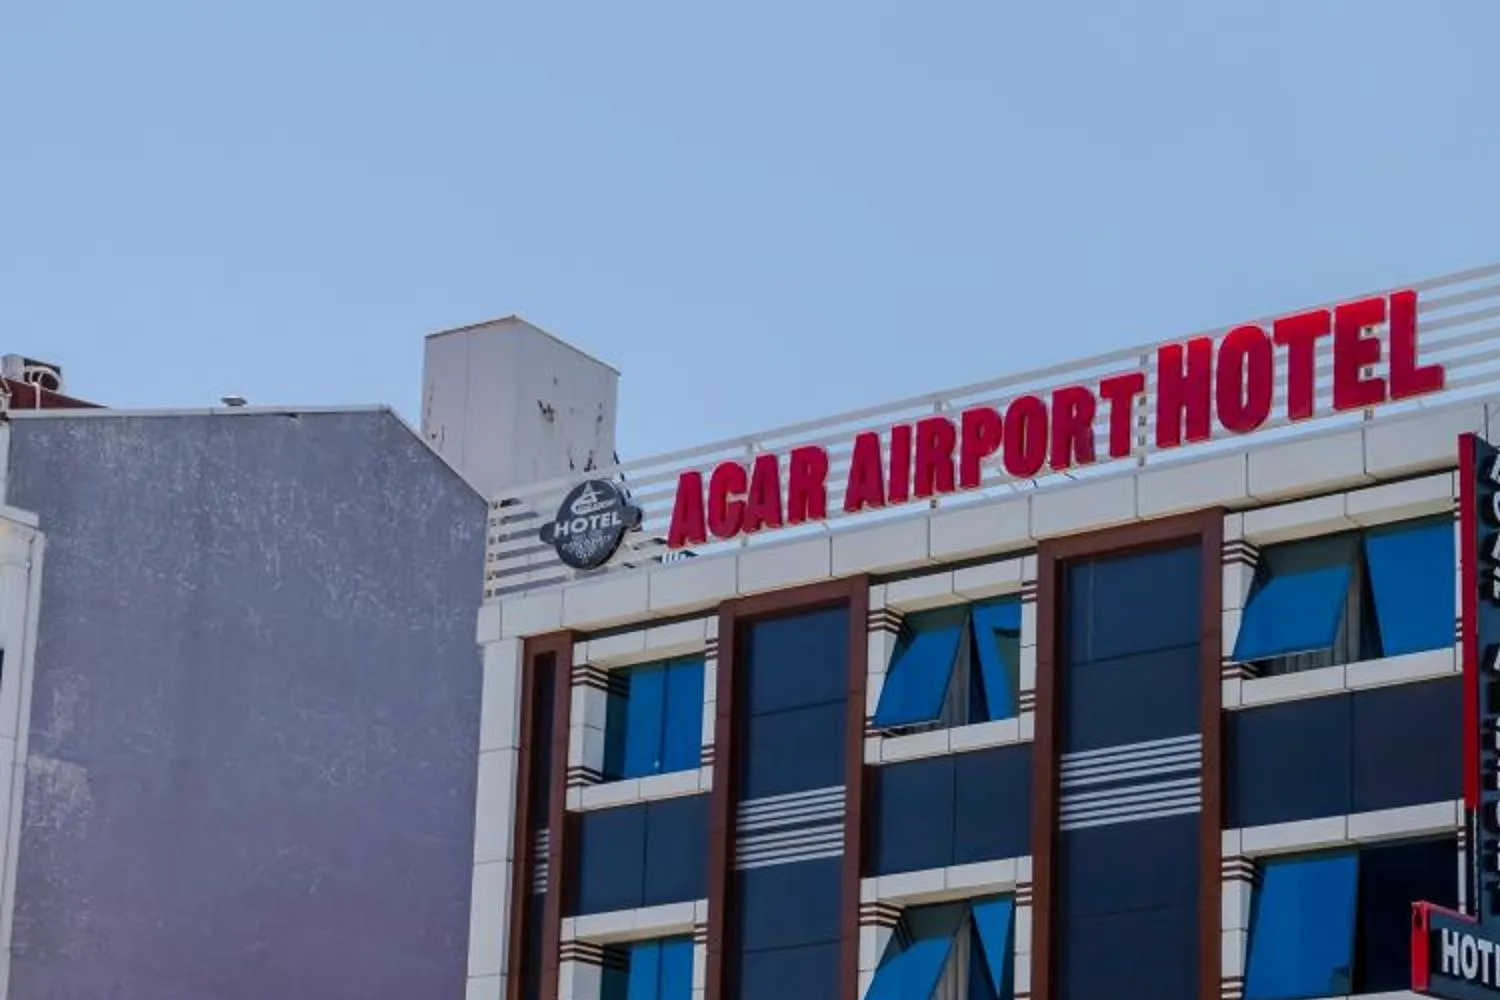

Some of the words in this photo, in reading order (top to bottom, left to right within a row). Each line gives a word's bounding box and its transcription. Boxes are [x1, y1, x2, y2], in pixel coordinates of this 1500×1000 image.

[666, 444, 829, 549] ACAR
[843, 371, 1145, 513] AIRPORT
[1156, 288, 1445, 449] HOTEL
[554, 511, 622, 538] HOTEL
